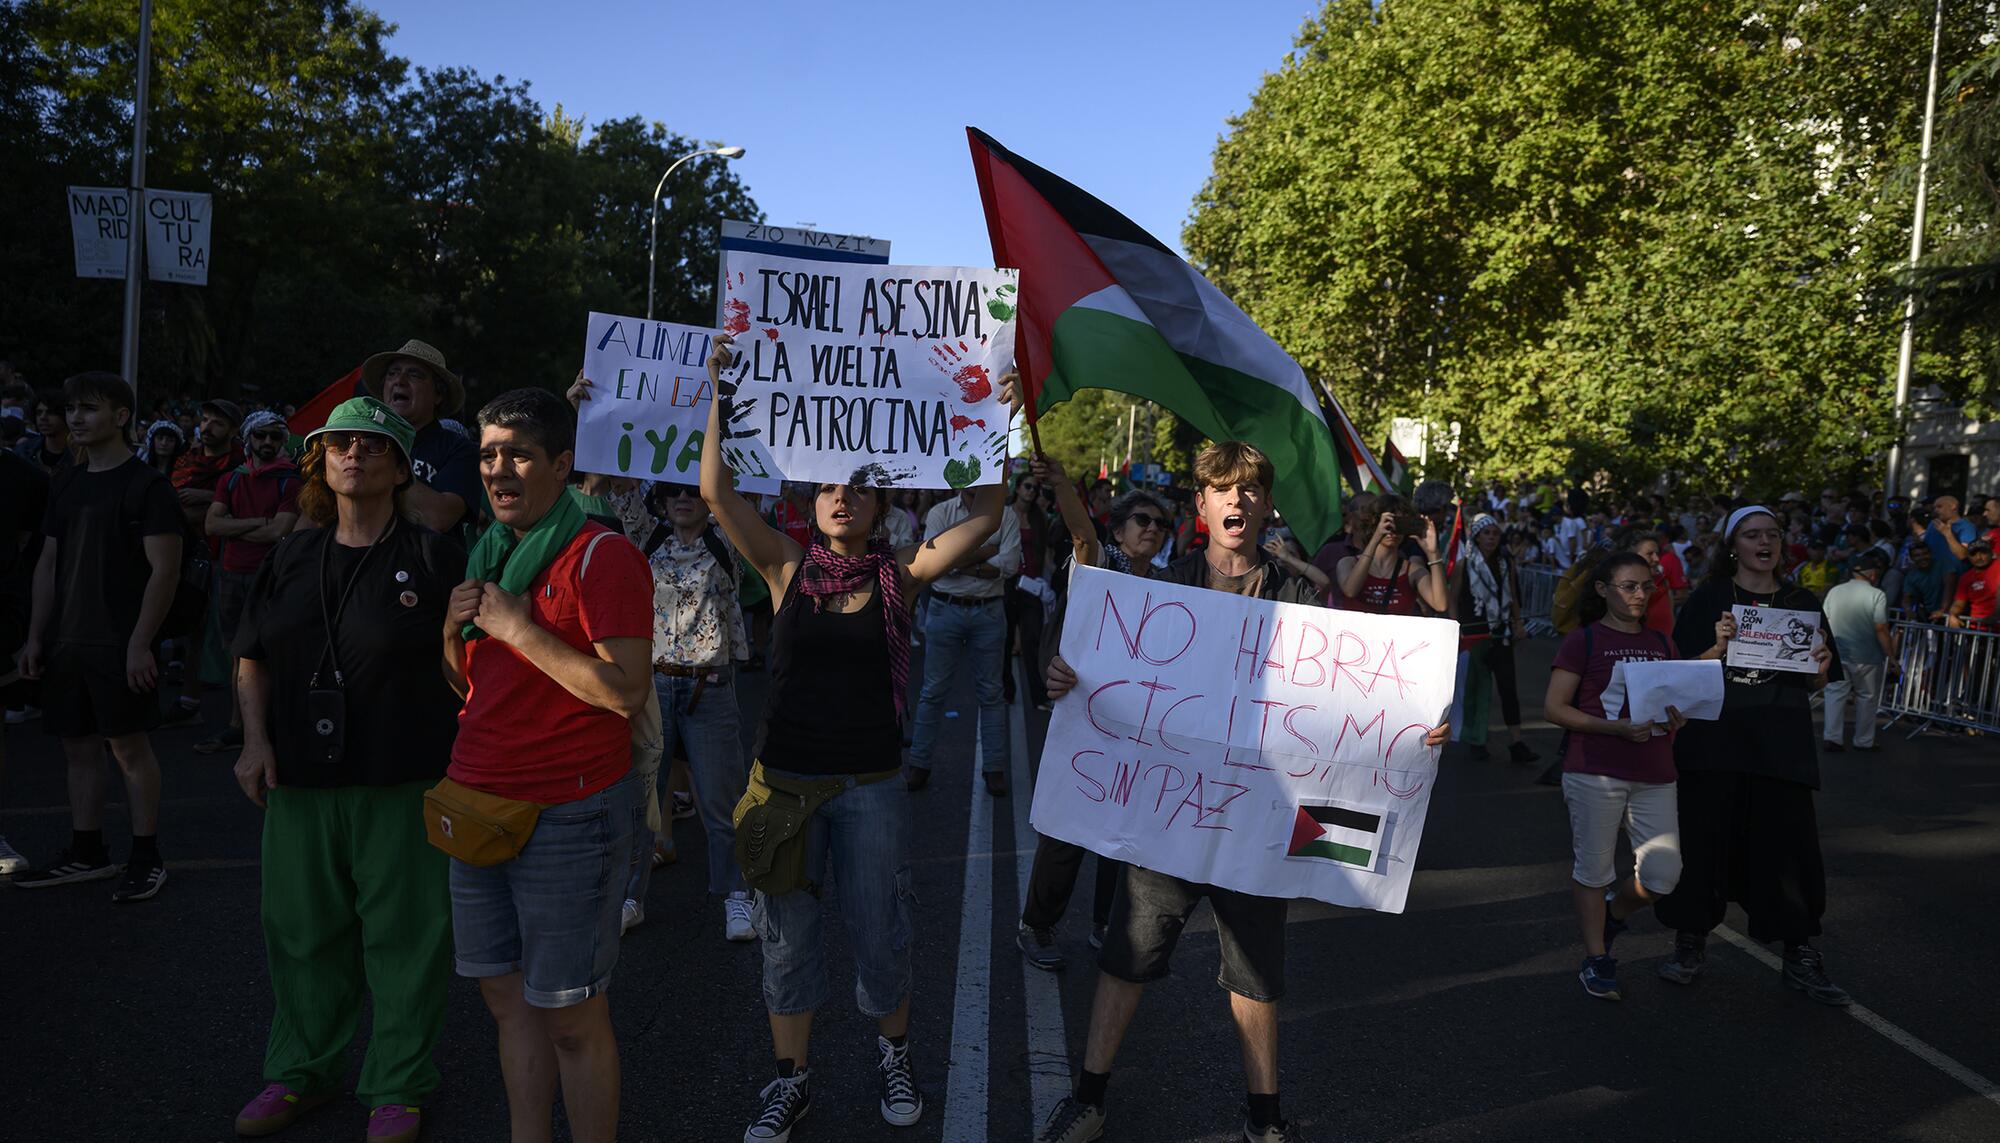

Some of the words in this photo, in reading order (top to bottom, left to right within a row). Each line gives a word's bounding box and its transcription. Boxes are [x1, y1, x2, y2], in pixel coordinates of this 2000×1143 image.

[72, 194, 128, 216] MAD
[149, 198, 200, 223] CUL
[98, 218, 129, 239] RID
[159, 221, 192, 244] TU
[745, 224, 784, 243] ZIO
[179, 246, 205, 268] RA
[755, 268, 843, 333] ISRAEL
[859, 277, 988, 346] ASESINA,
[753, 340, 792, 383] LA
[810, 343, 901, 388] VUELTA
[616, 368, 659, 402] EN
[769, 391, 951, 457] PATROCINA
[1741, 616, 1763, 624] CON
[1743, 608, 1758, 617] NO
[1096, 589, 1197, 666] NO
[1234, 614, 1430, 699] HABRÁ
[1739, 629, 1783, 641] SILENCIO
[1604, 648, 1648, 657] PALESTINA
[1086, 675, 1434, 800] CICLISMO
[1072, 750, 1140, 807] SIN
[1144, 763, 1250, 832] PAZ
